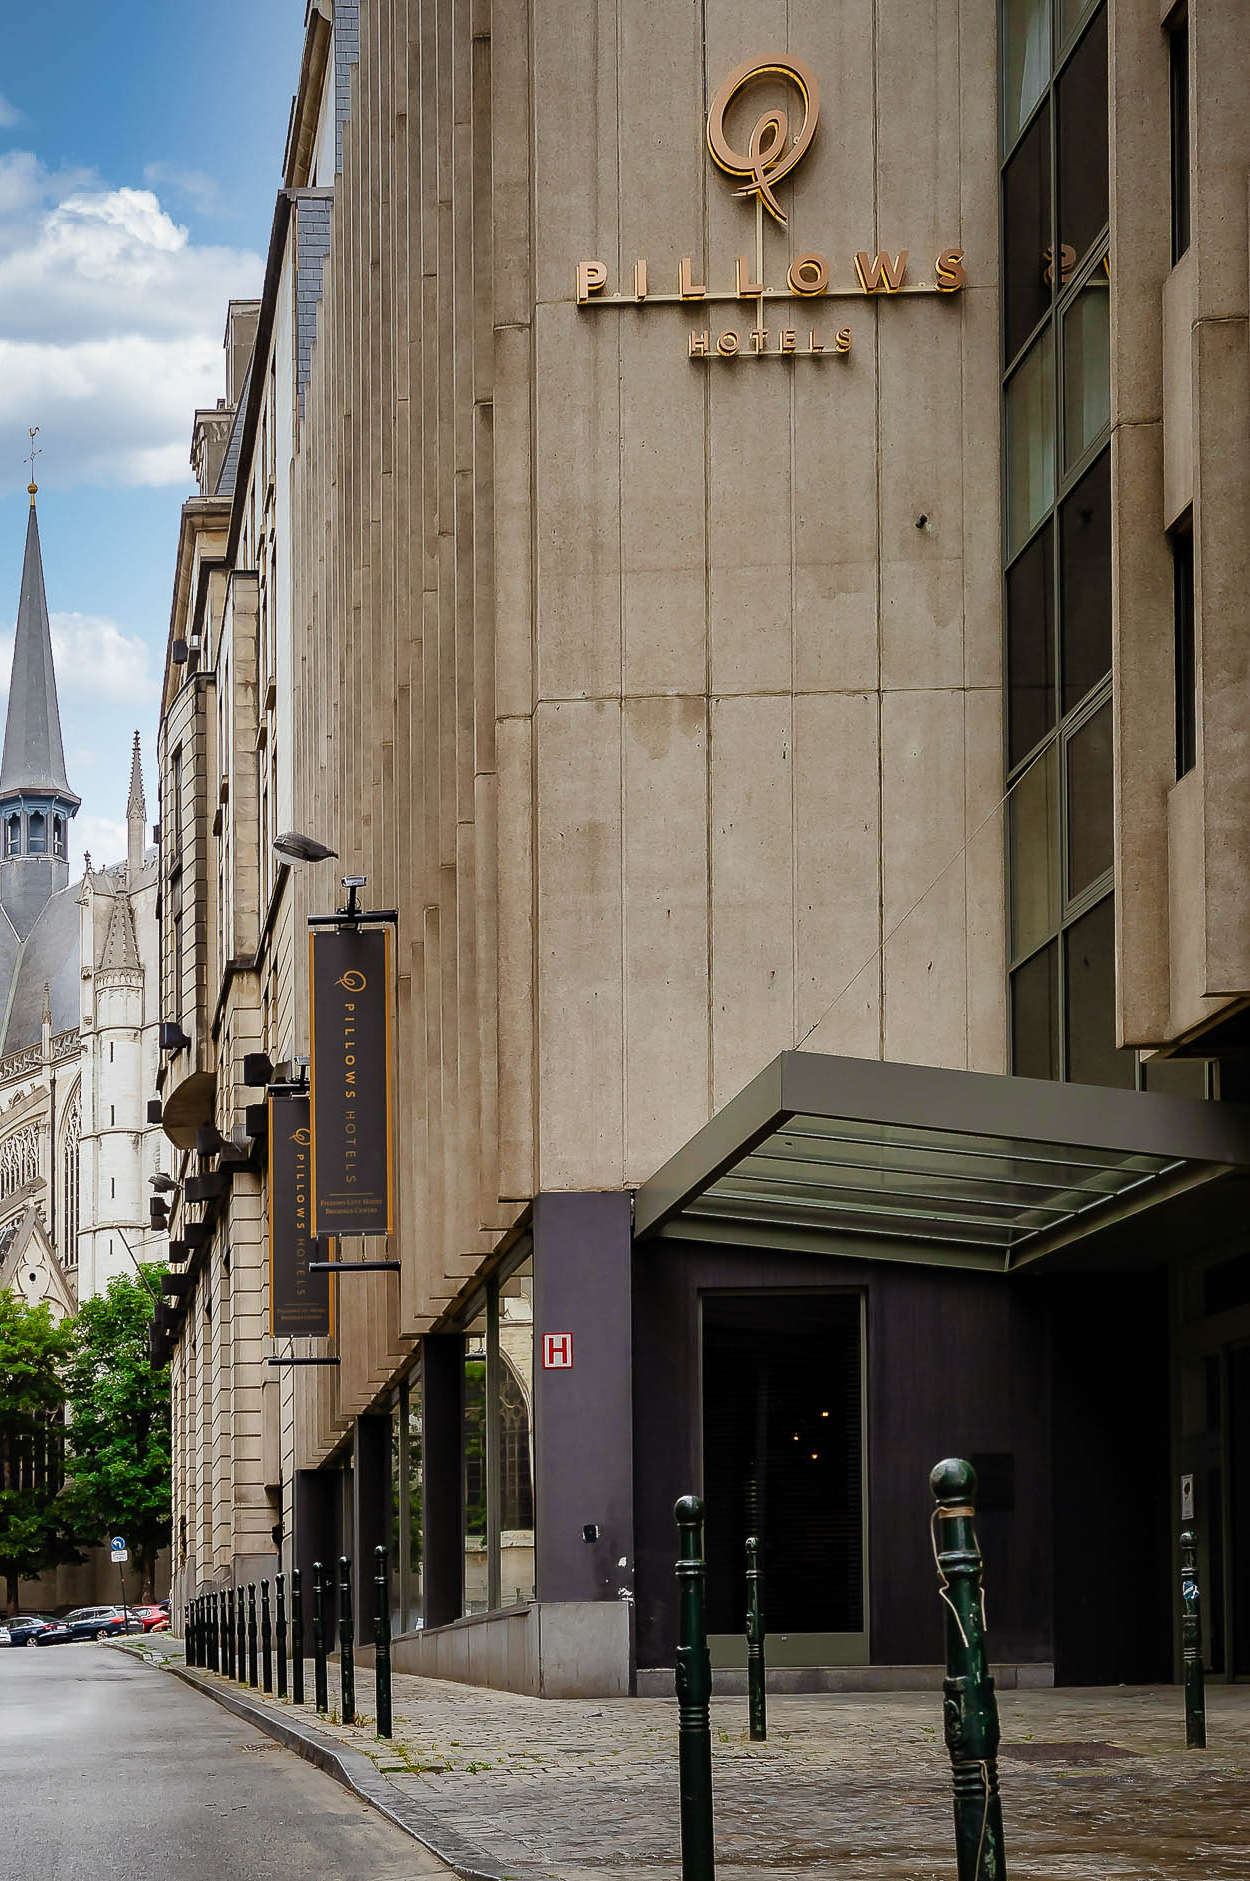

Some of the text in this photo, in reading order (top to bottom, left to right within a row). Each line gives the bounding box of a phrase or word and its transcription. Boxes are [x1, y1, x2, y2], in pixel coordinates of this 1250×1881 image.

[576, 249, 966, 303] PILLOWS
[689, 326, 853, 357] HOTELS
[344, 1003, 357, 1183] PILLOWS HOTELS
[296, 1154, 306, 1295] PILLOWS HOTELS
[548, 1337, 567, 1364] H
